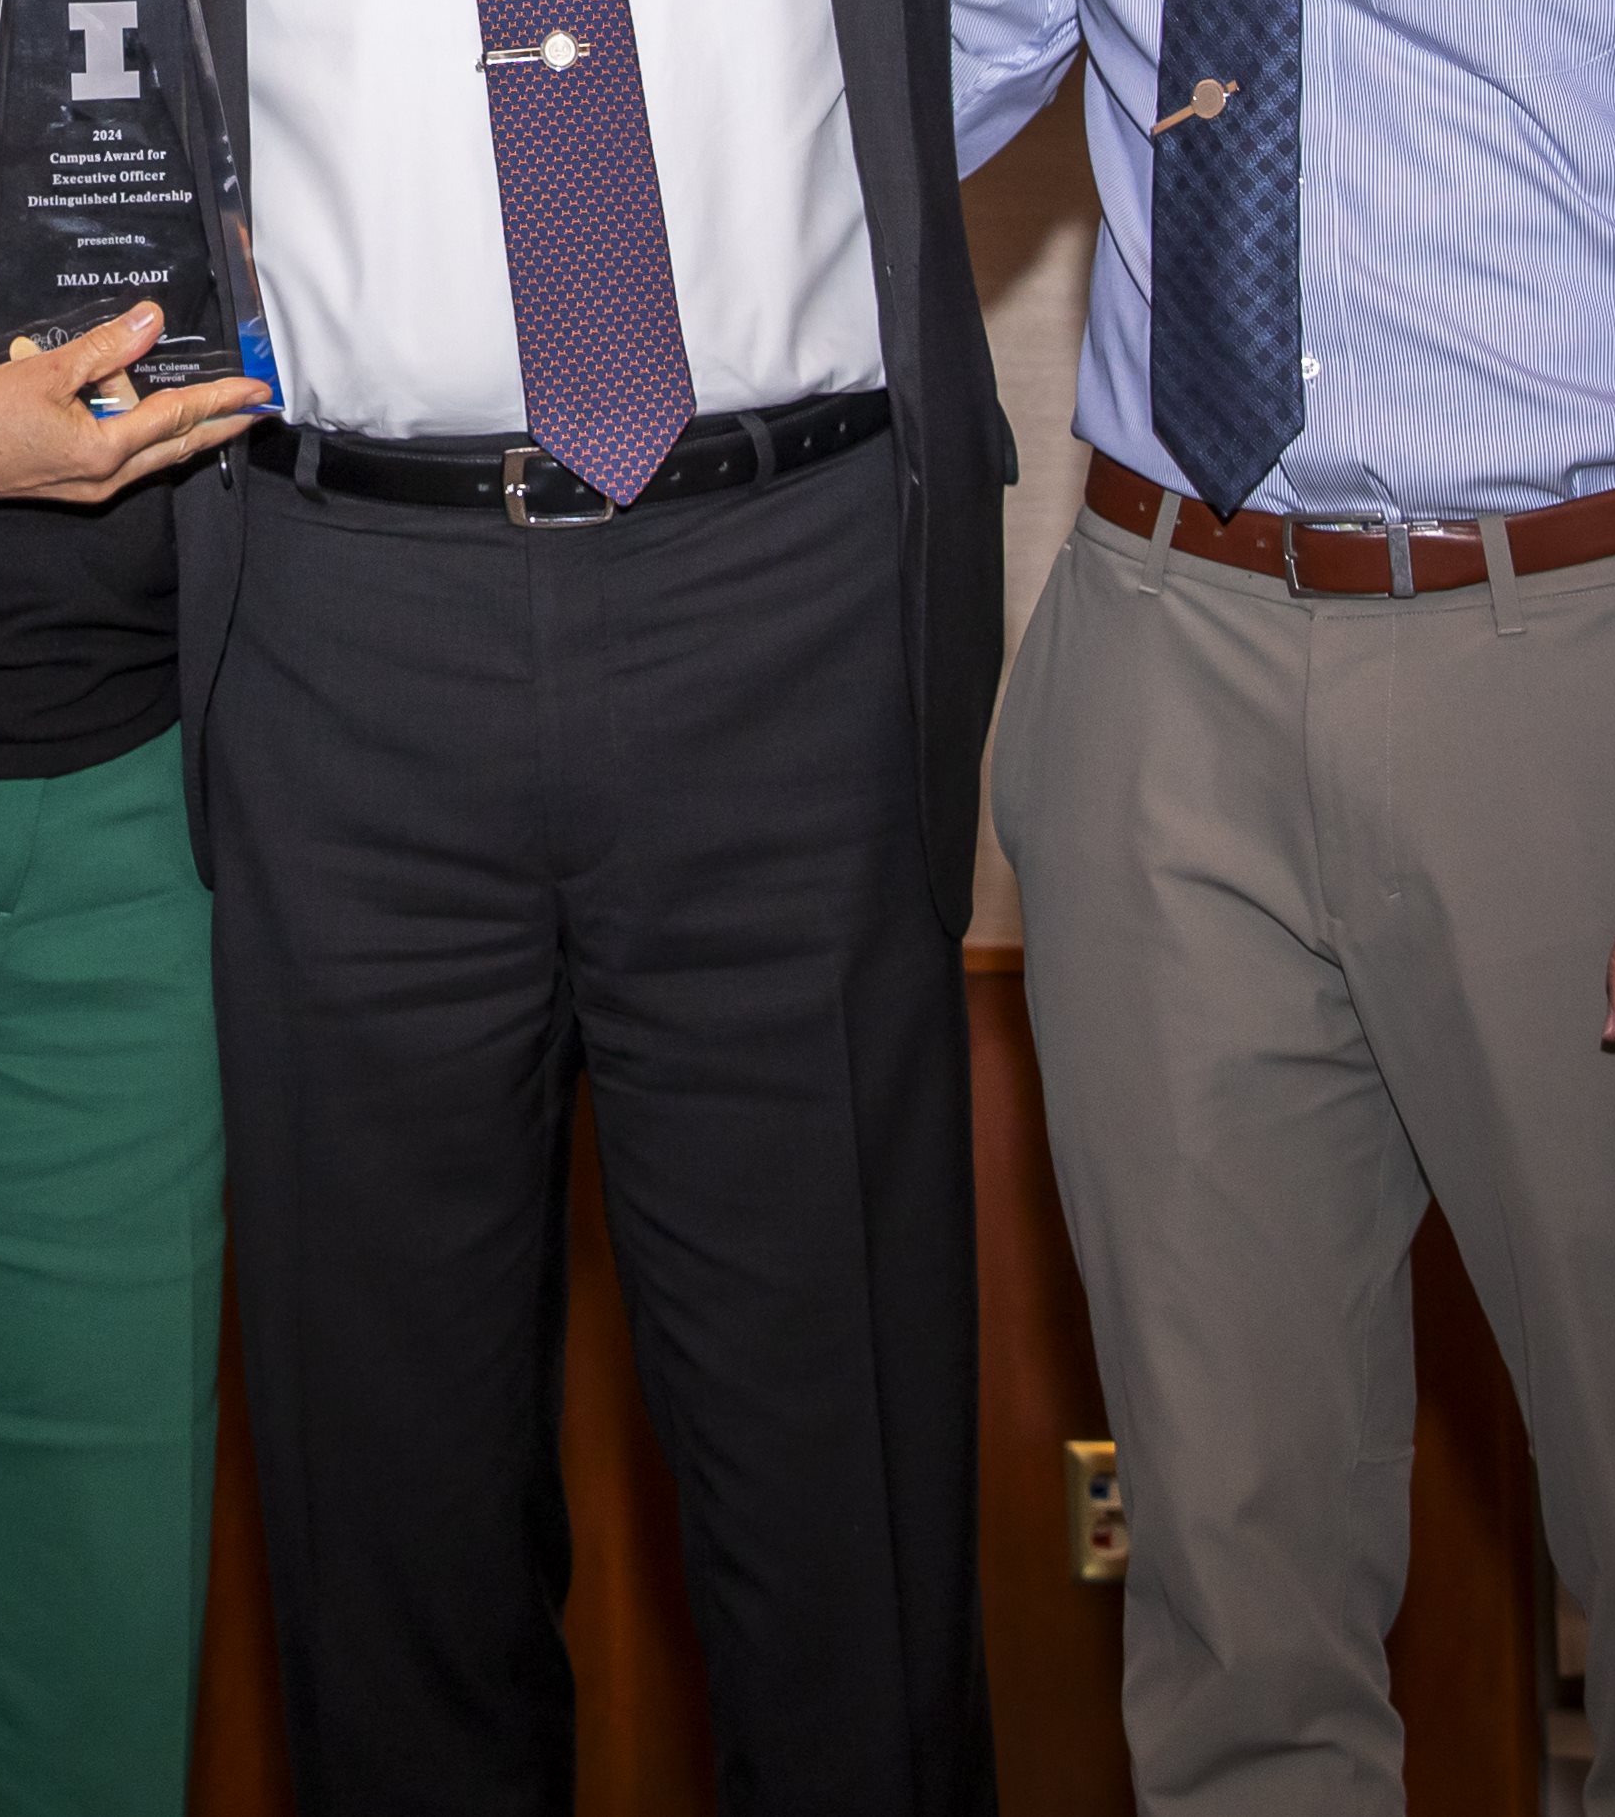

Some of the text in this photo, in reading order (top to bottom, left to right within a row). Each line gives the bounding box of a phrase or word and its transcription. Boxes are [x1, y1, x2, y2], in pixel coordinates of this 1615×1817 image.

[68, 0, 141, 101] I
[92, 129, 122, 141] 2024
[49, 149, 167, 165] Campus Award for
[52, 170, 166, 185] Executive Officer
[27, 189, 193, 207] Distinguished Leadership
[77, 234, 146, 248] presented to
[56, 270, 169, 287] IMAD AL-QADI
[134, 363, 200, 373] John Coleman
[149, 374, 186, 383] Provost
